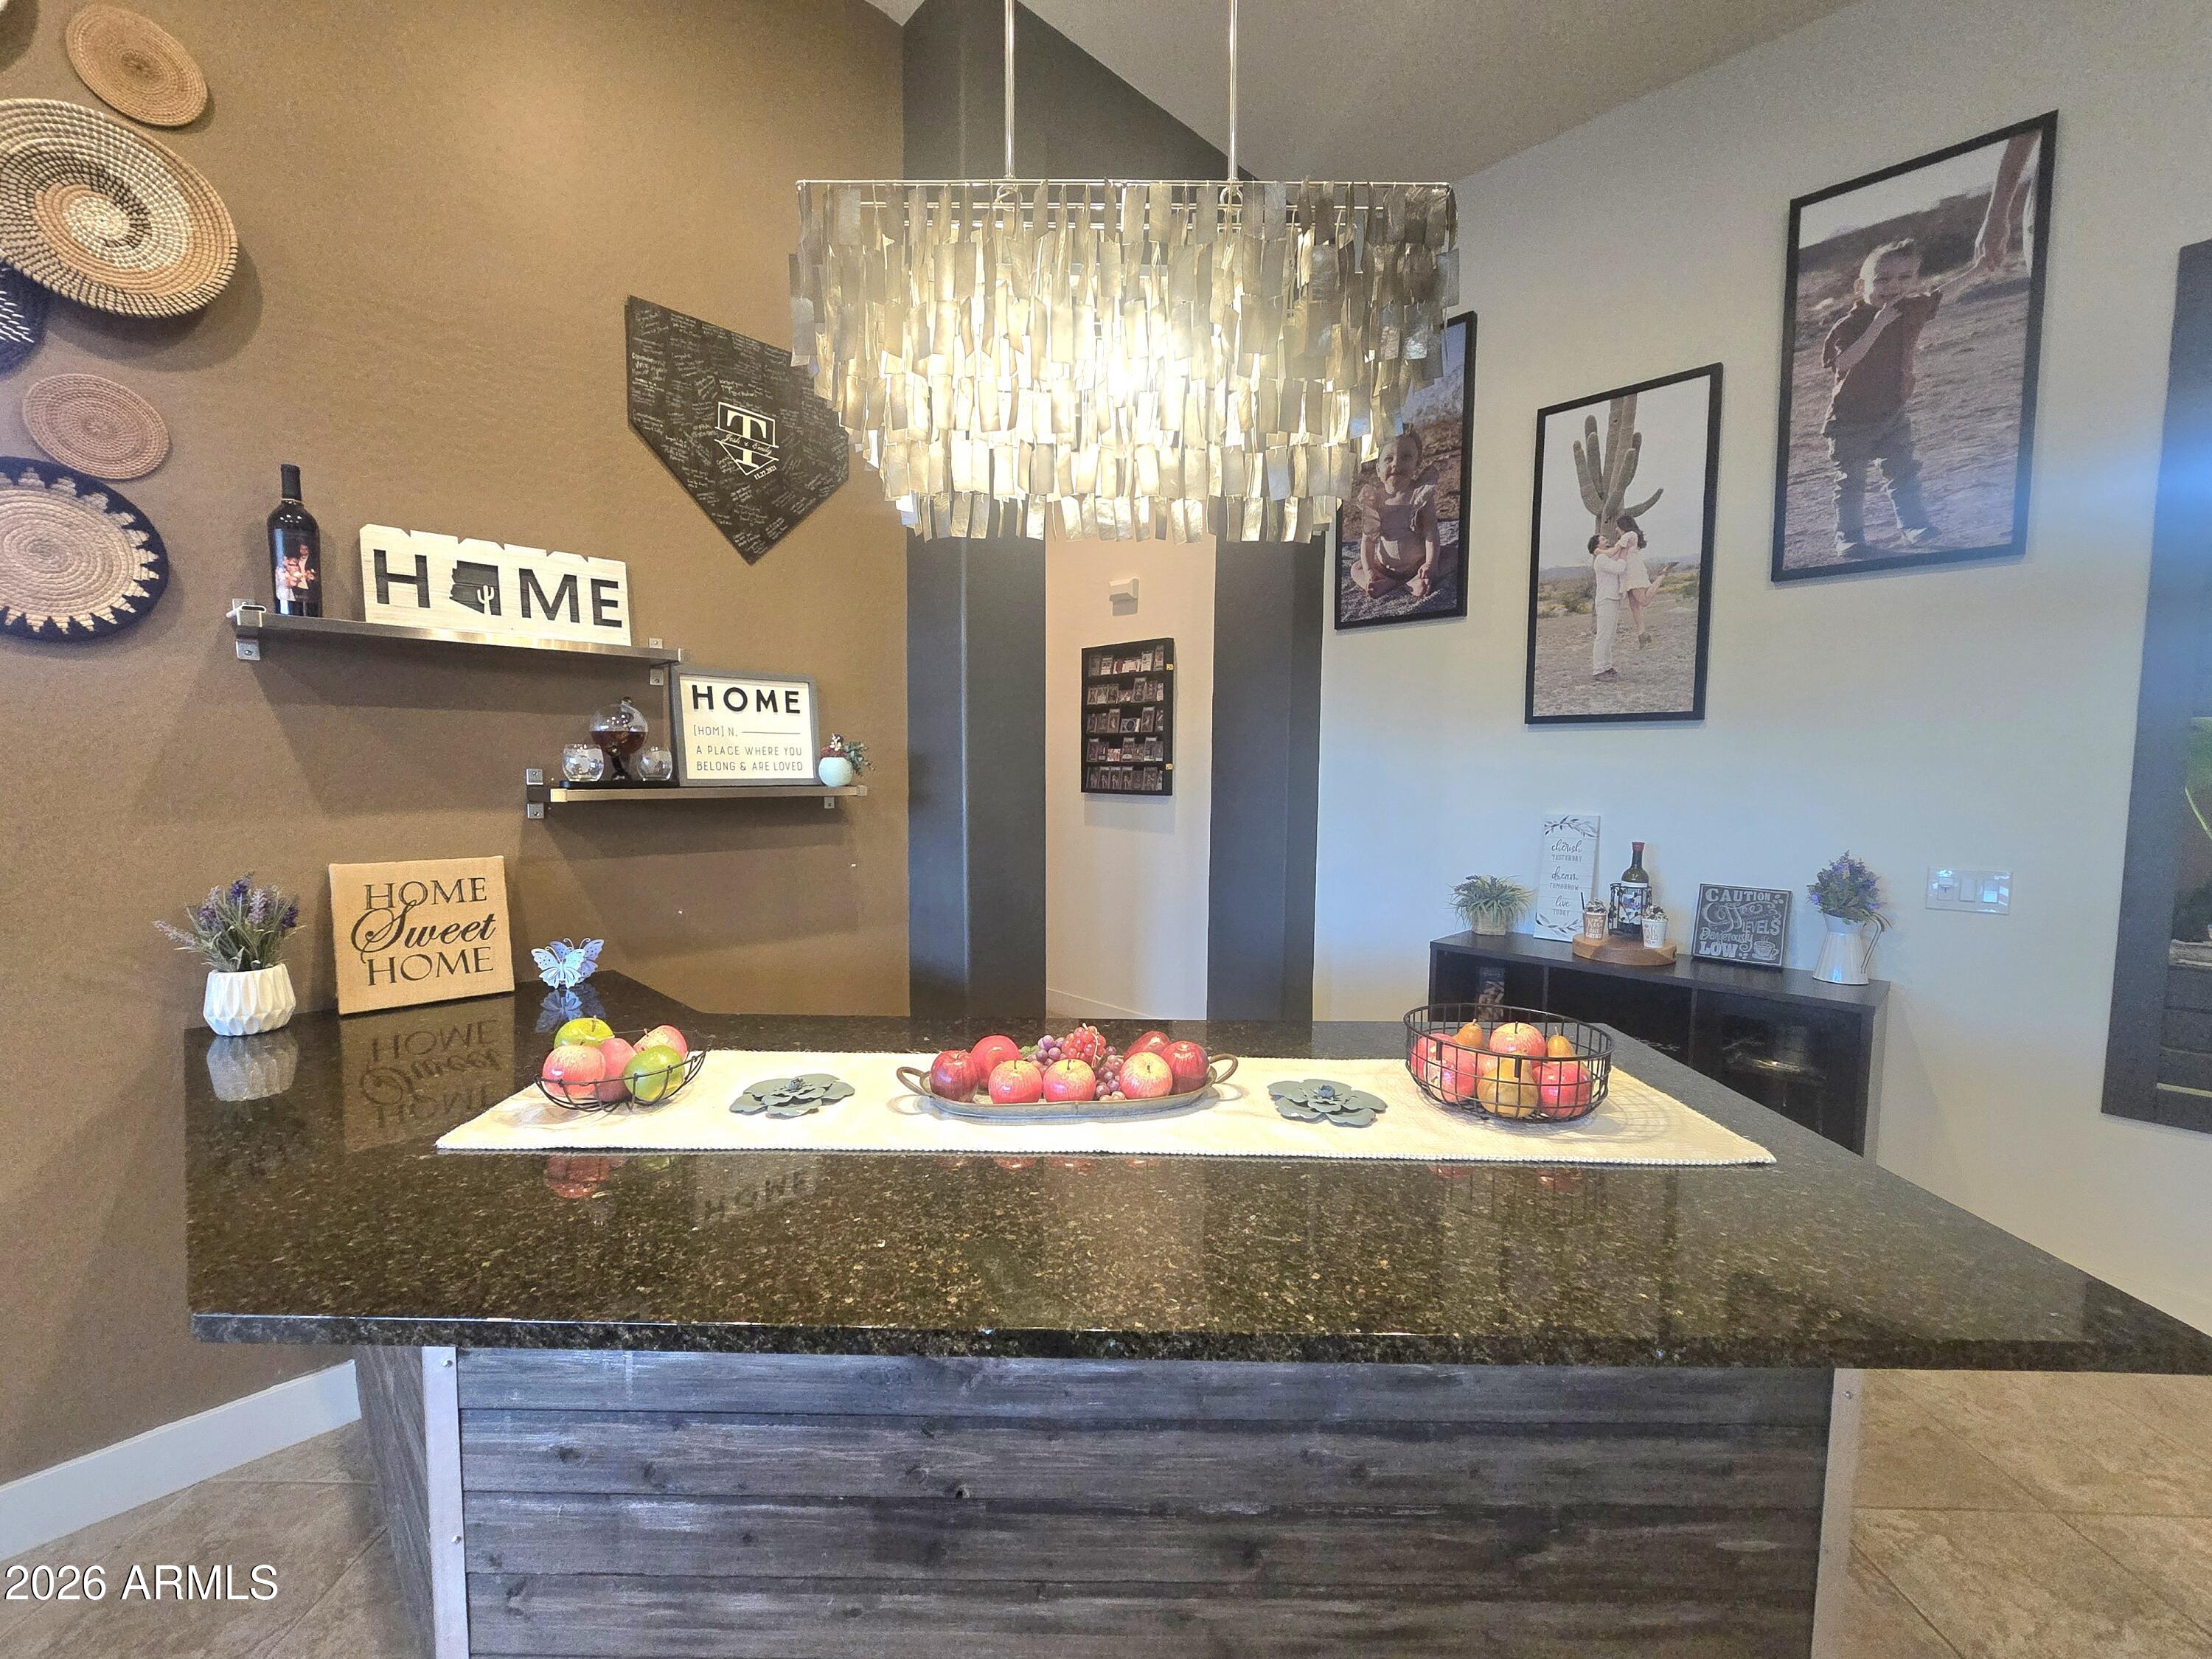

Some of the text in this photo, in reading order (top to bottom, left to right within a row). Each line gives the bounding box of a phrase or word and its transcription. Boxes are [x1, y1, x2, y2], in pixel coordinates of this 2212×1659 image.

[726, 409, 766, 468] T
[373, 549, 623, 628] HME
[692, 684, 801, 714] HOME
[693, 725, 738, 737] [HOM] N.
[696, 745, 802, 756] A PLACE WHERE YOU
[697, 761, 804, 771] BELONG & ARE LOVED
[1551, 839, 1583, 853] cherish
[1551, 866, 1579, 880] dream
[364, 877, 487, 911] HOME
[1549, 883, 1579, 891] TOMORROW
[1705, 888, 1771, 902] CAUTION
[1555, 895, 1571, 907] live
[350, 900, 496, 964] Sweet
[1742, 919, 1781, 936] LEVELS
[1699, 927, 1753, 952] Dangerously
[1699, 941, 1739, 958] LOW
[367, 945, 494, 987] HOME
